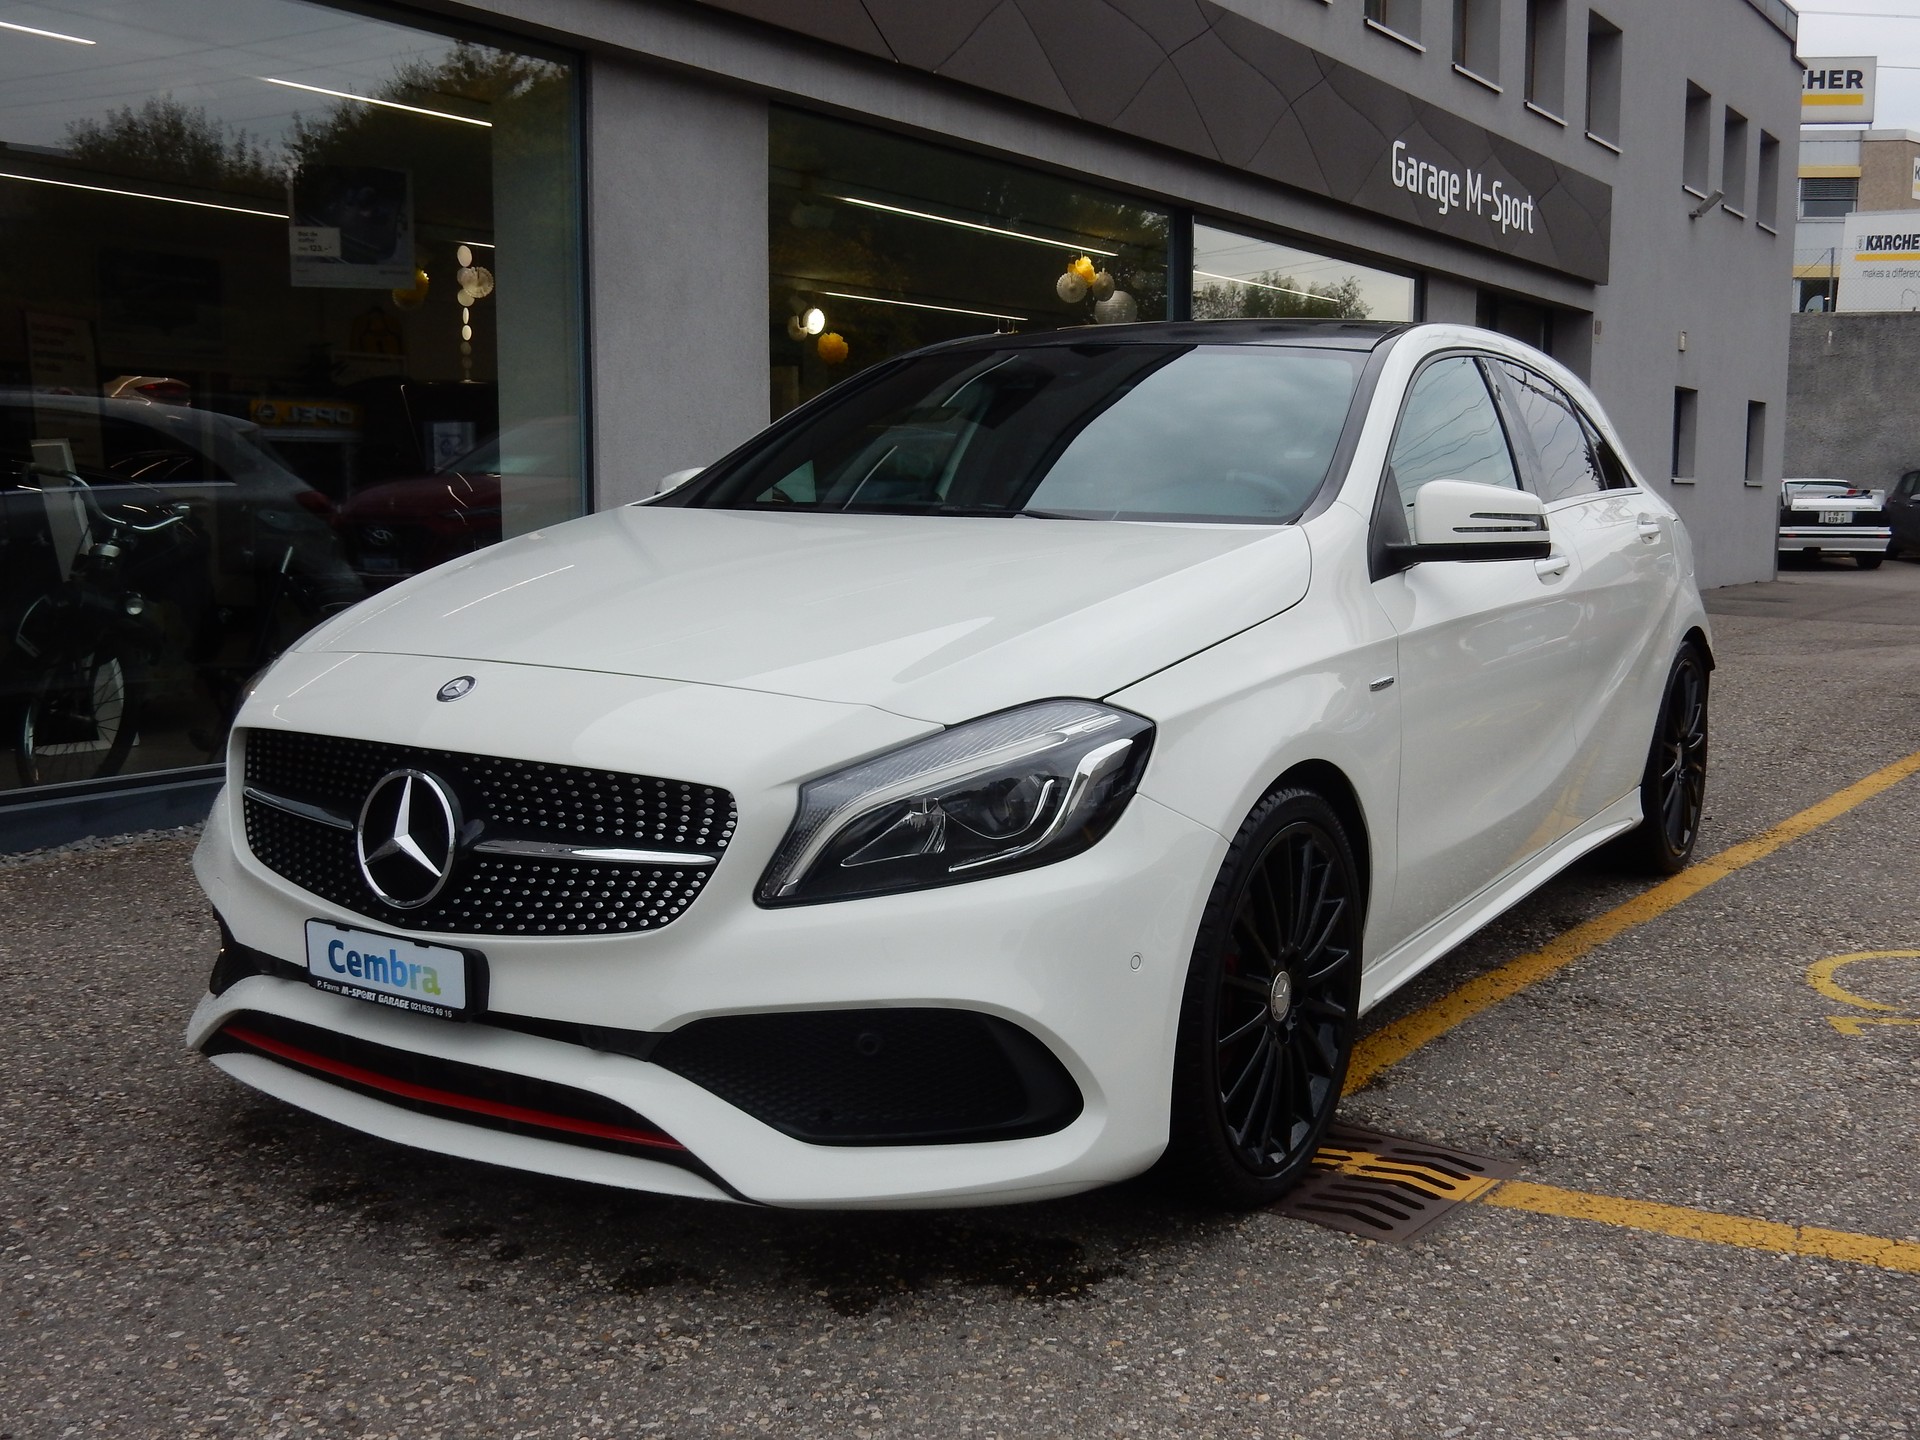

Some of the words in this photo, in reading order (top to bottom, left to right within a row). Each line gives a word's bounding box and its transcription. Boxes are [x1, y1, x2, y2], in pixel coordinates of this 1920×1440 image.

[1803, 70, 1863, 89] HER
[1391, 139, 1460, 215] Garage
[1465, 168, 1534, 235] M-Sport
[1862, 267, 1884, 278] makes
[1885, 270, 1891, 278] a
[328, 939, 442, 996] Cembra
[341, 985, 376, 1001] M-SPORT
[378, 994, 410, 1009] GARAGE
